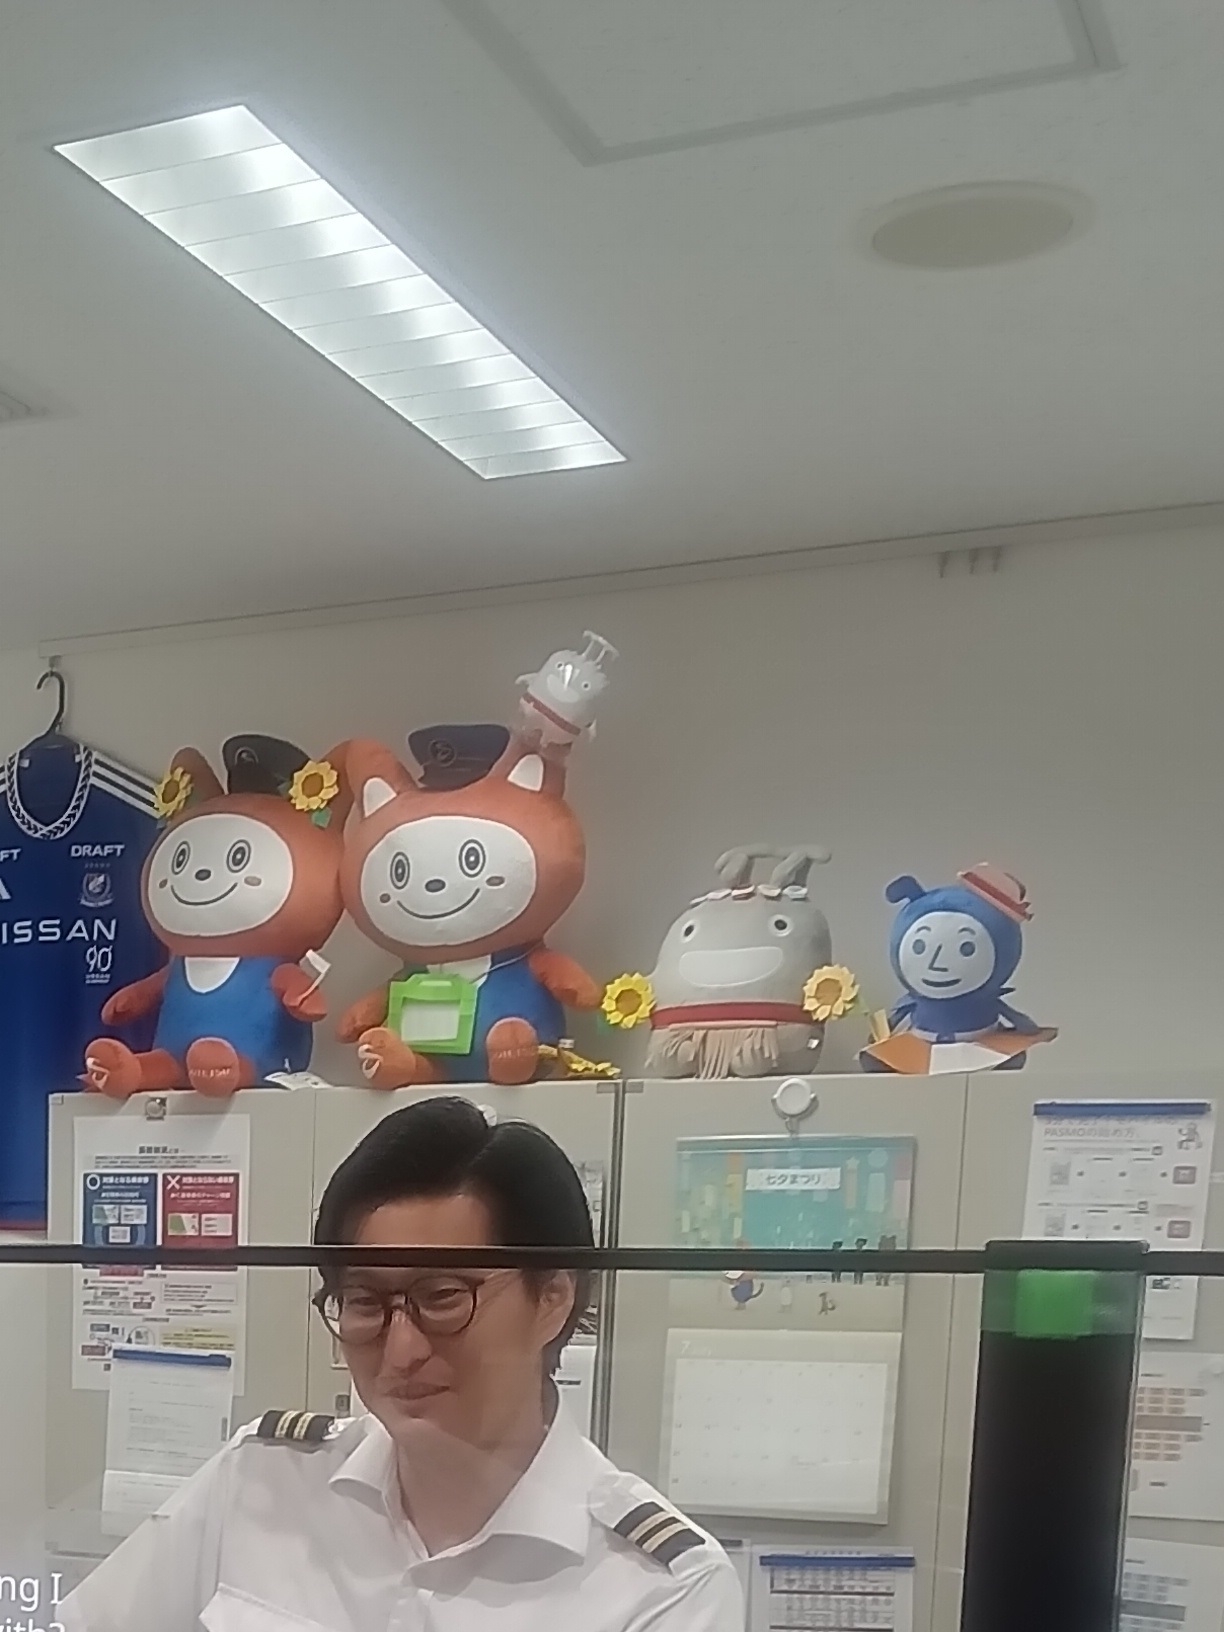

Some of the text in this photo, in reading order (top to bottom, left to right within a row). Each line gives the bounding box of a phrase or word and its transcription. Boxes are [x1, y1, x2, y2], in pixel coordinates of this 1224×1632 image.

[70, 843, 126, 859] DRAFT
[765, 1172, 822, 1186] 七夕まつり
[49, 1572, 64, 1605] I
